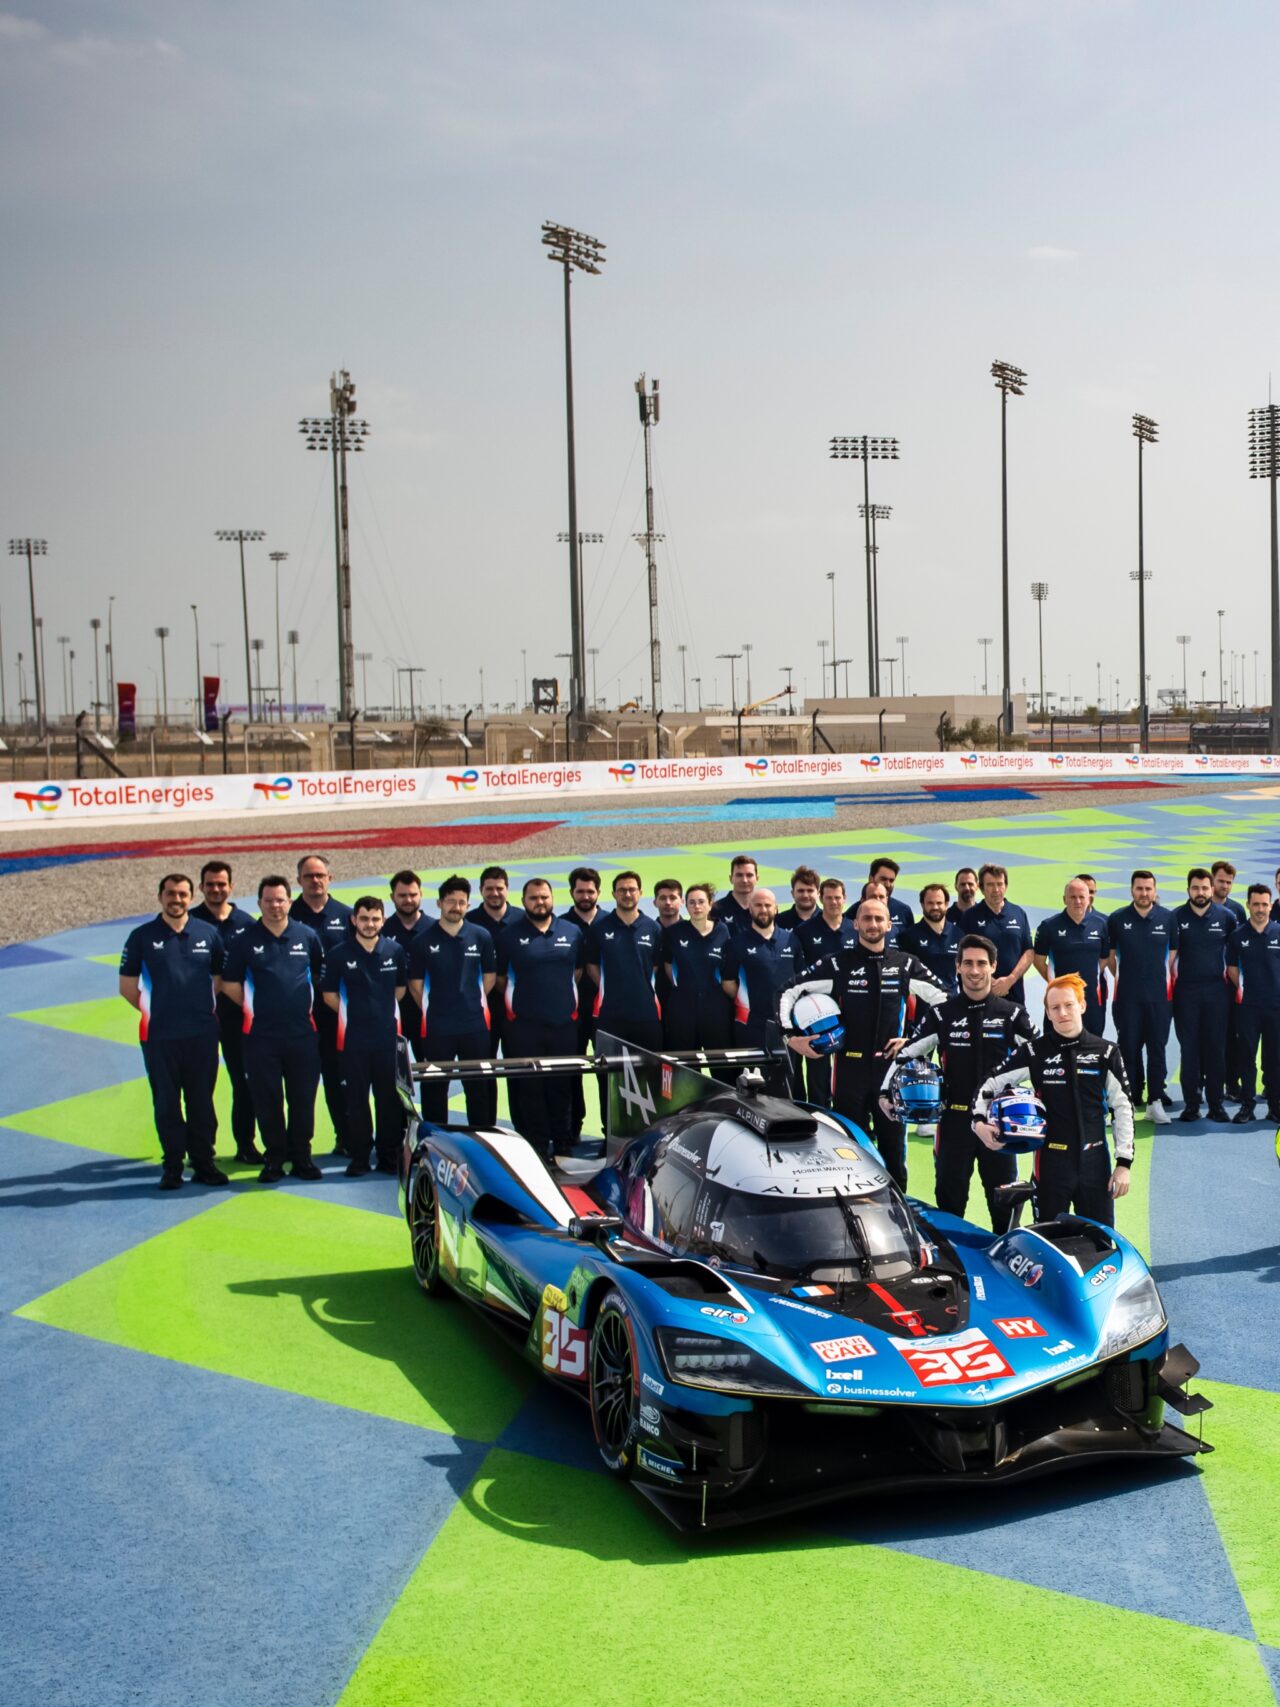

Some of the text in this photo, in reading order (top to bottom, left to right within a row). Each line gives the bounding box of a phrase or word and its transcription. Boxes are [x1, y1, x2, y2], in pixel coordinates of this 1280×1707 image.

[639, 762, 723, 781] TotalEnergies
[769, 758, 842, 777] TotalEnergies
[883, 756, 945, 774] TotalEnergies
[979, 755, 1034, 770] TotalEnergies
[1065, 756, 1113, 770] TotalEnergies
[1141, 757, 1184, 770] TotalEnergies
[1209, 758, 1250, 769] TotalEnergies
[297, 774, 416, 797] TotalEnergies
[483, 766, 582, 787] TotalEnergies
[68, 782, 214, 808] TotalEnergies
[662, 1068, 673, 1094] HY
[736, 1107, 767, 1129] ALPINE
[437, 1159, 457, 1188] elf
[761, 1174, 888, 1195] ALPINE
[1009, 1254, 1034, 1277] elf
[1090, 1270, 1108, 1286] elf
[700, 1307, 732, 1319] elf
[996, 1319, 1039, 1336] HY
[542, 1309, 585, 1376] 35
[815, 1337, 863, 1350] HYPER
[822, 1344, 871, 1360] CAR
[908, 1343, 1006, 1383] 35
[843, 1385, 917, 1397] businessolver
[639, 1417, 660, 1437] BAHCO
[648, 1459, 676, 1475] MICHE
